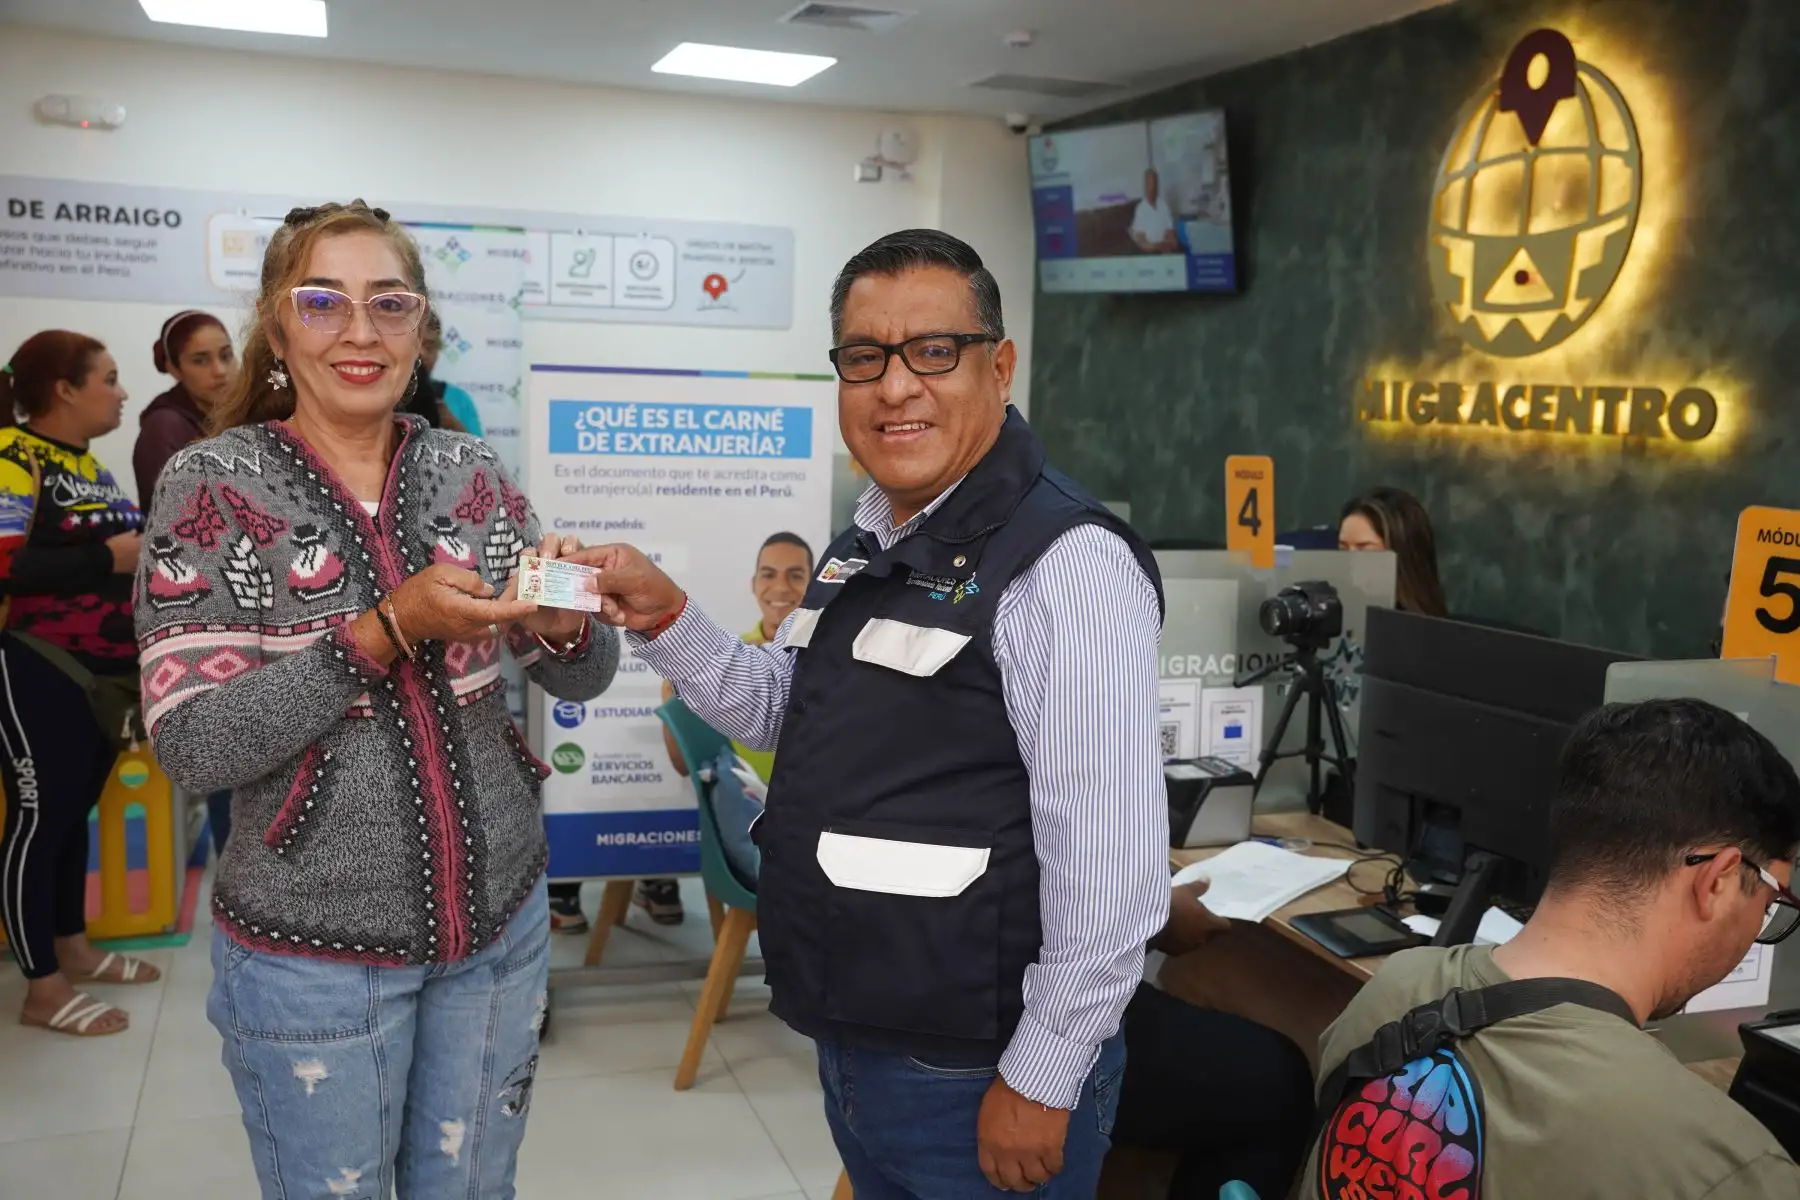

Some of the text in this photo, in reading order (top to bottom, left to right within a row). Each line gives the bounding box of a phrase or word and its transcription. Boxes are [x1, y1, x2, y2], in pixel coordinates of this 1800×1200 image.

[8, 198, 183, 228] DE ARRAIGO
[574, 404, 785, 432] ¿QUÉ ES EL CARNÉ
[1357, 379, 1719, 441] MIGRACENTRO
[577, 431, 786, 456] DE EXTRANJERÍA?
[554, 464, 807, 484] Es el documento que te acredita como
[564, 483, 653, 498] extranjero(a)
[656, 484, 722, 497] residente
[724, 486, 742, 497] en
[744, 485, 757, 497] el
[553, 518, 576, 529] Con
[578, 519, 602, 529] este
[1238, 487, 1262, 537] 4
[1755, 556, 1800, 634] 5
[1159, 652, 1296, 677] IGRACIONE
[593, 706, 653, 718] ESTUDIAR
[592, 760, 654, 771] SERVICIOS
[13, 757, 39, 810] SPORT
[591, 773, 663, 785] BANCARIOS
